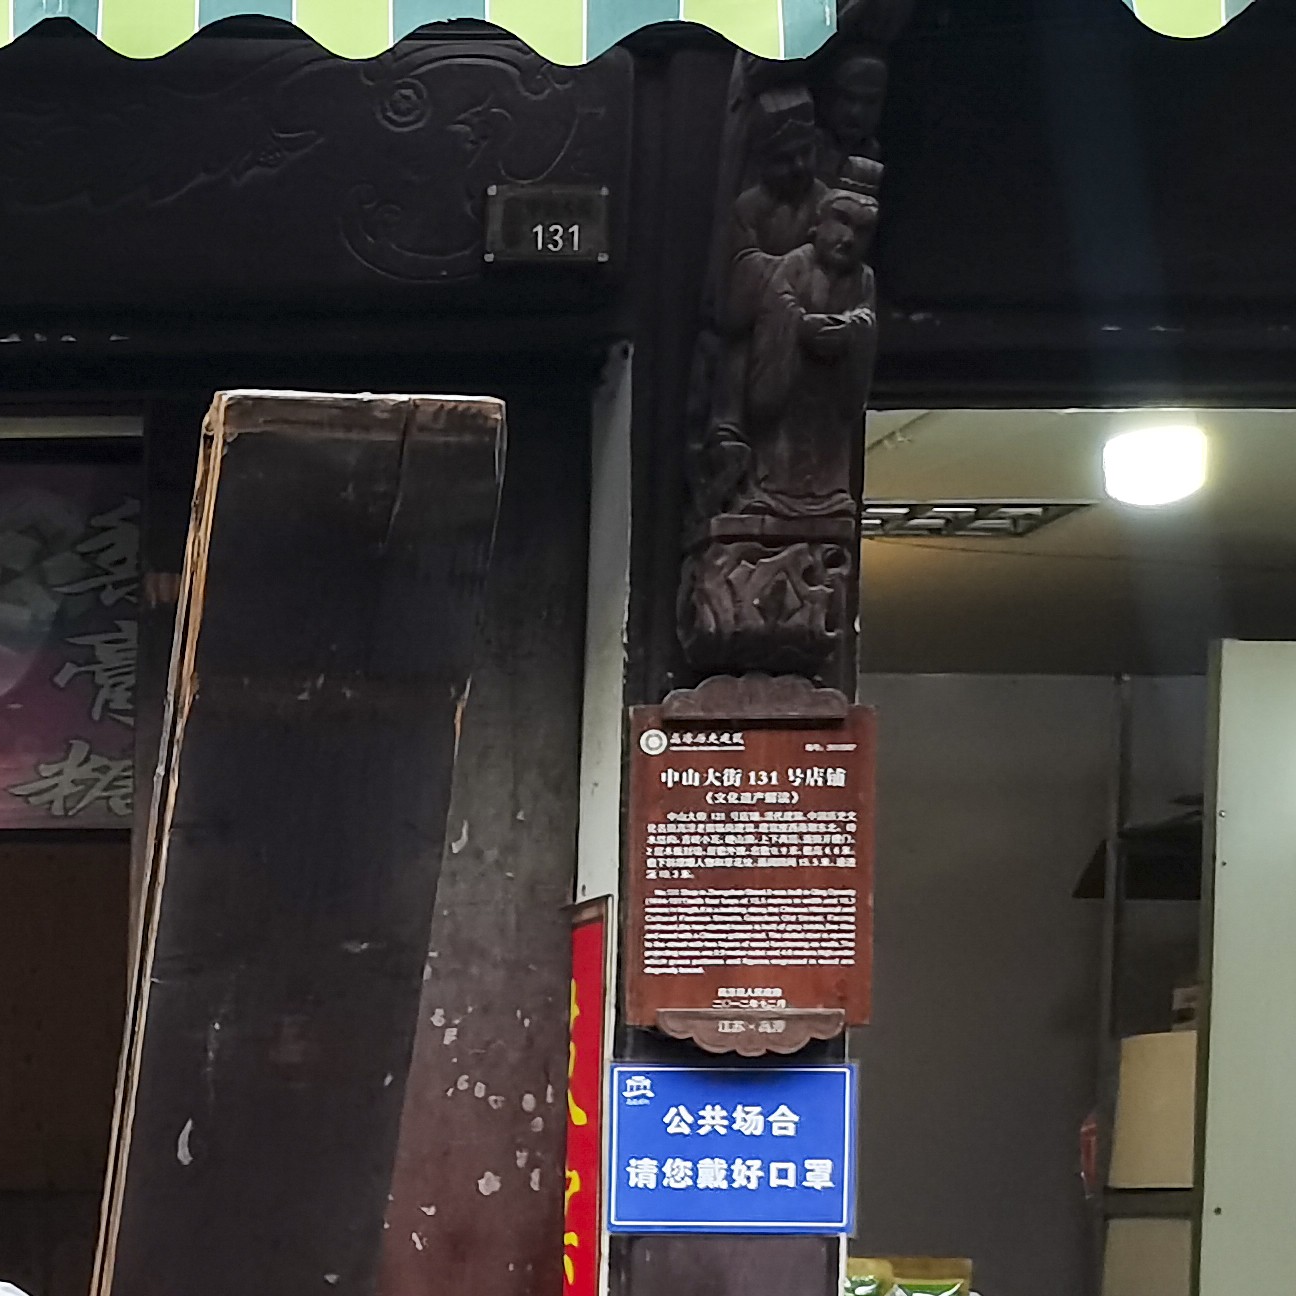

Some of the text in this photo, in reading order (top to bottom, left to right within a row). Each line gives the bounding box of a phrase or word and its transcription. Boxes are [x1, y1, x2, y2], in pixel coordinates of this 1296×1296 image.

[532, 223, 580, 252] 131
[660, 767, 847, 788] 中山大街 131 号店铺
[662, 1104, 800, 1137] 公共场合
[625, 1156, 836, 1191] 请您戴好口罩
